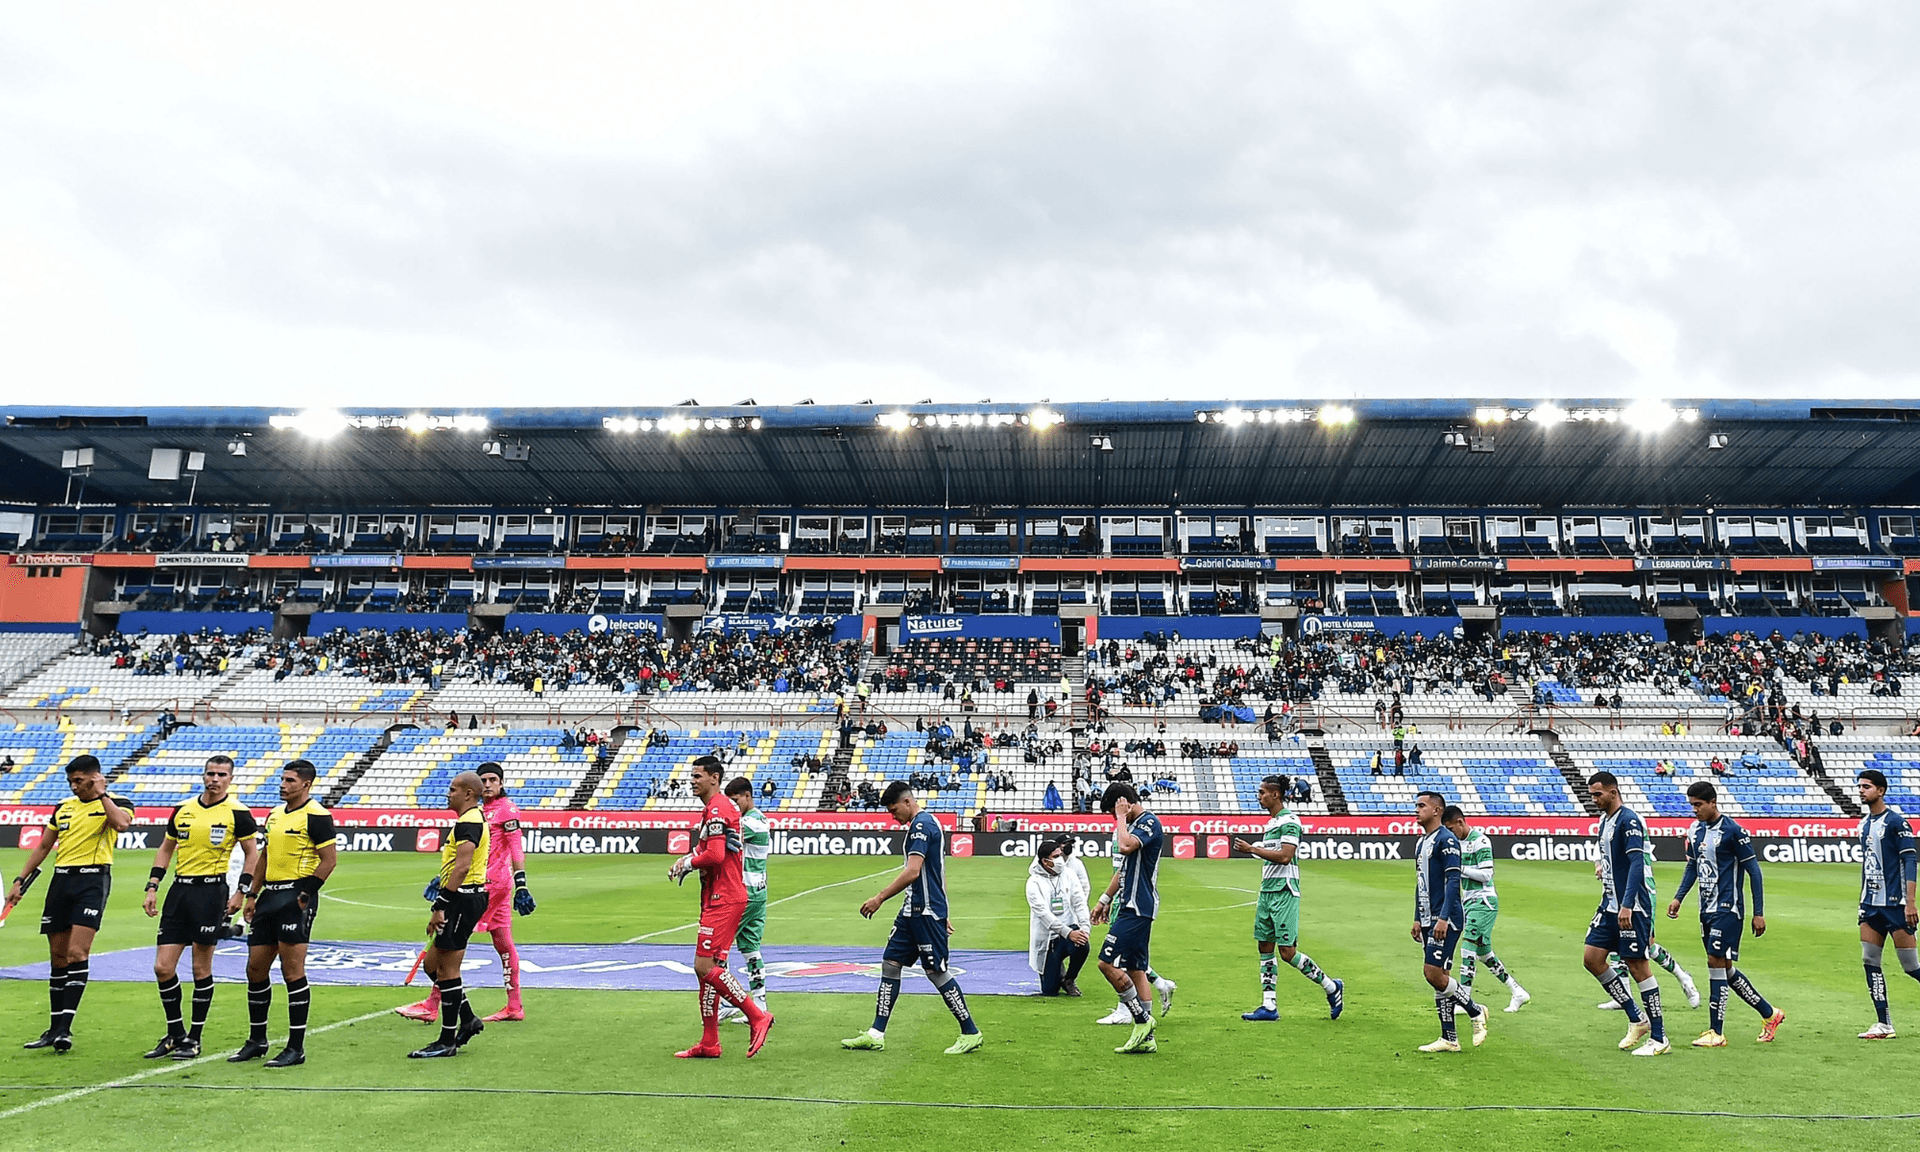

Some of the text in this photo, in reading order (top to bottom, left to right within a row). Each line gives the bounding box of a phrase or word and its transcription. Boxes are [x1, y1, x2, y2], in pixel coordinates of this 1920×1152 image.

[1196, 558, 1262, 568] Gabriel Caballero
[1426, 558, 1493, 568] Jaime Correa
[1692, 559, 1713, 568] LÓPEZ
[609, 619, 655, 630] telecable
[1342, 619, 1353, 628] VÍA
[79, 866, 99, 874] Comex
[84, 907, 98, 917] FMF
[200, 925, 215, 933] FMF
[282, 923, 297, 932] FMF
[883, 982, 893, 1011] FORTEC
